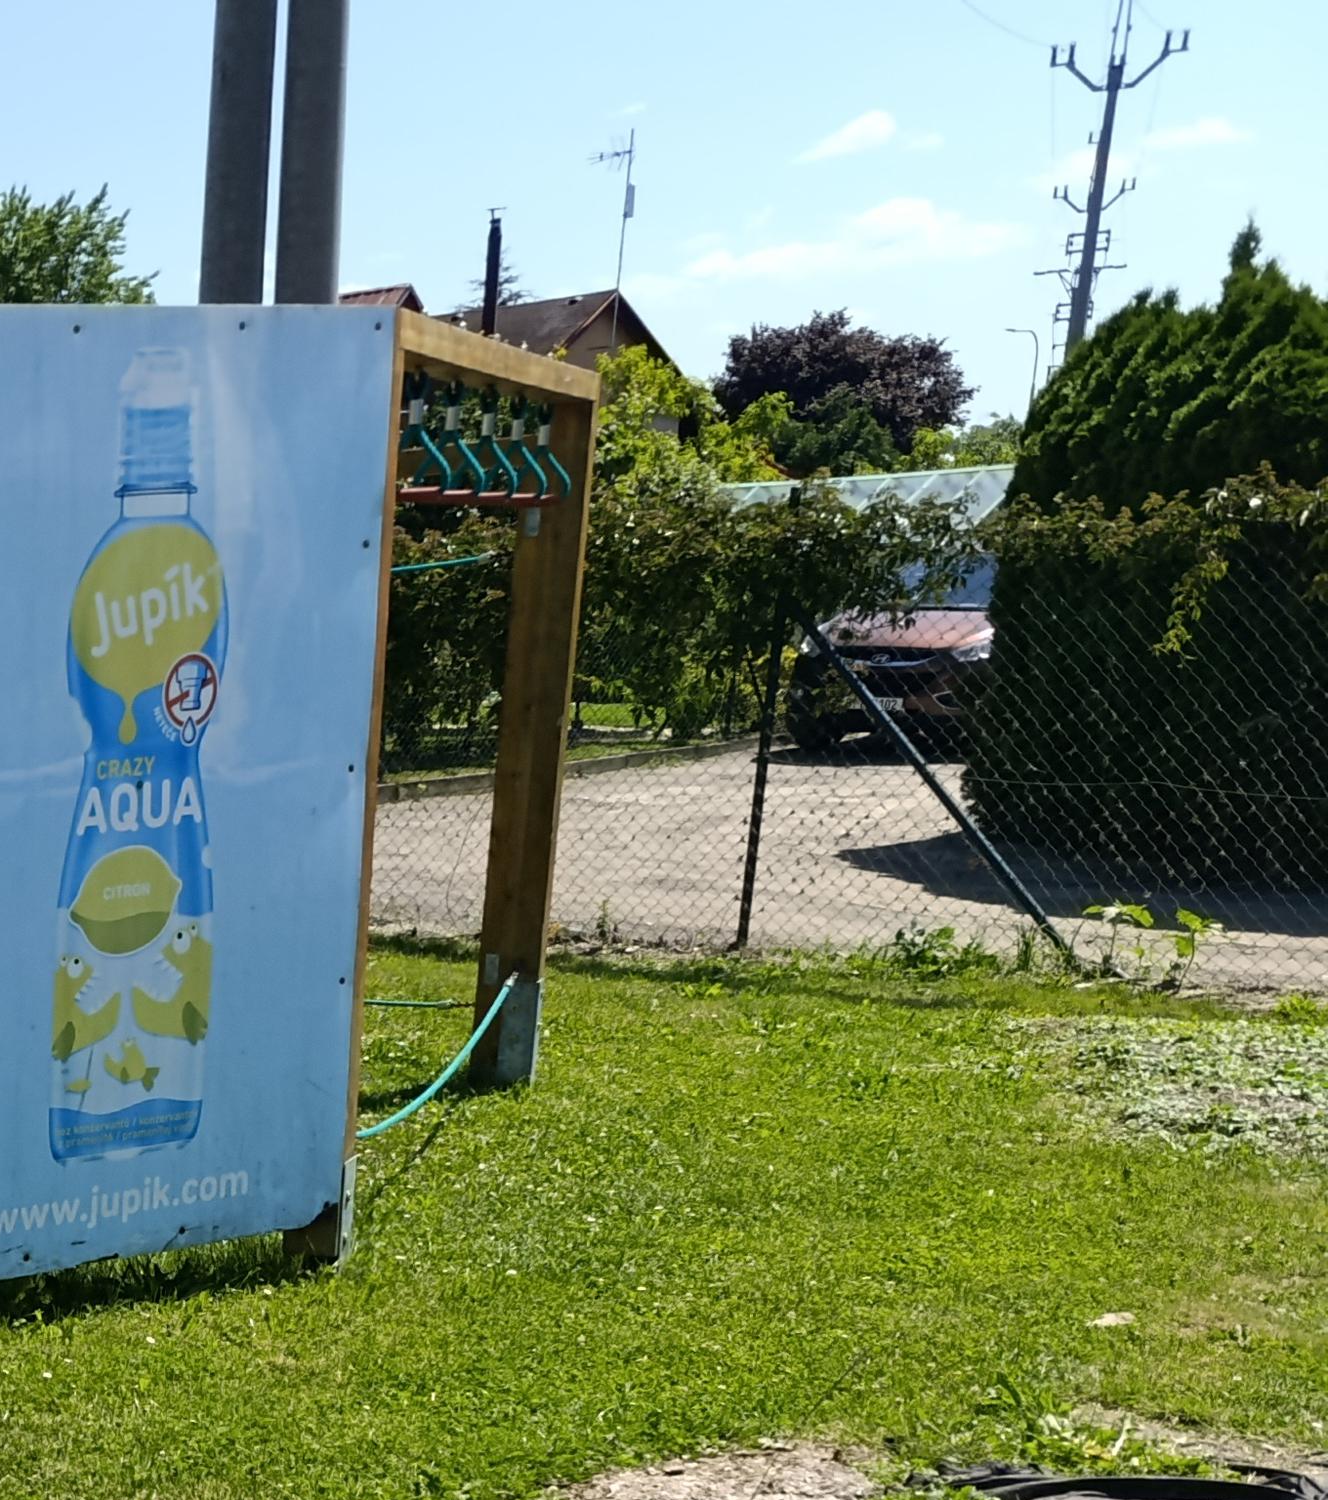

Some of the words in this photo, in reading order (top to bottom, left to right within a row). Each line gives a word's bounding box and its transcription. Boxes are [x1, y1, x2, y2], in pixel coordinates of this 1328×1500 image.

[90, 562, 209, 657] Jupík
[96, 756, 155, 780] CRAZY
[76, 776, 202, 836] AQUA
[103, 882, 151, 900] CITRON
